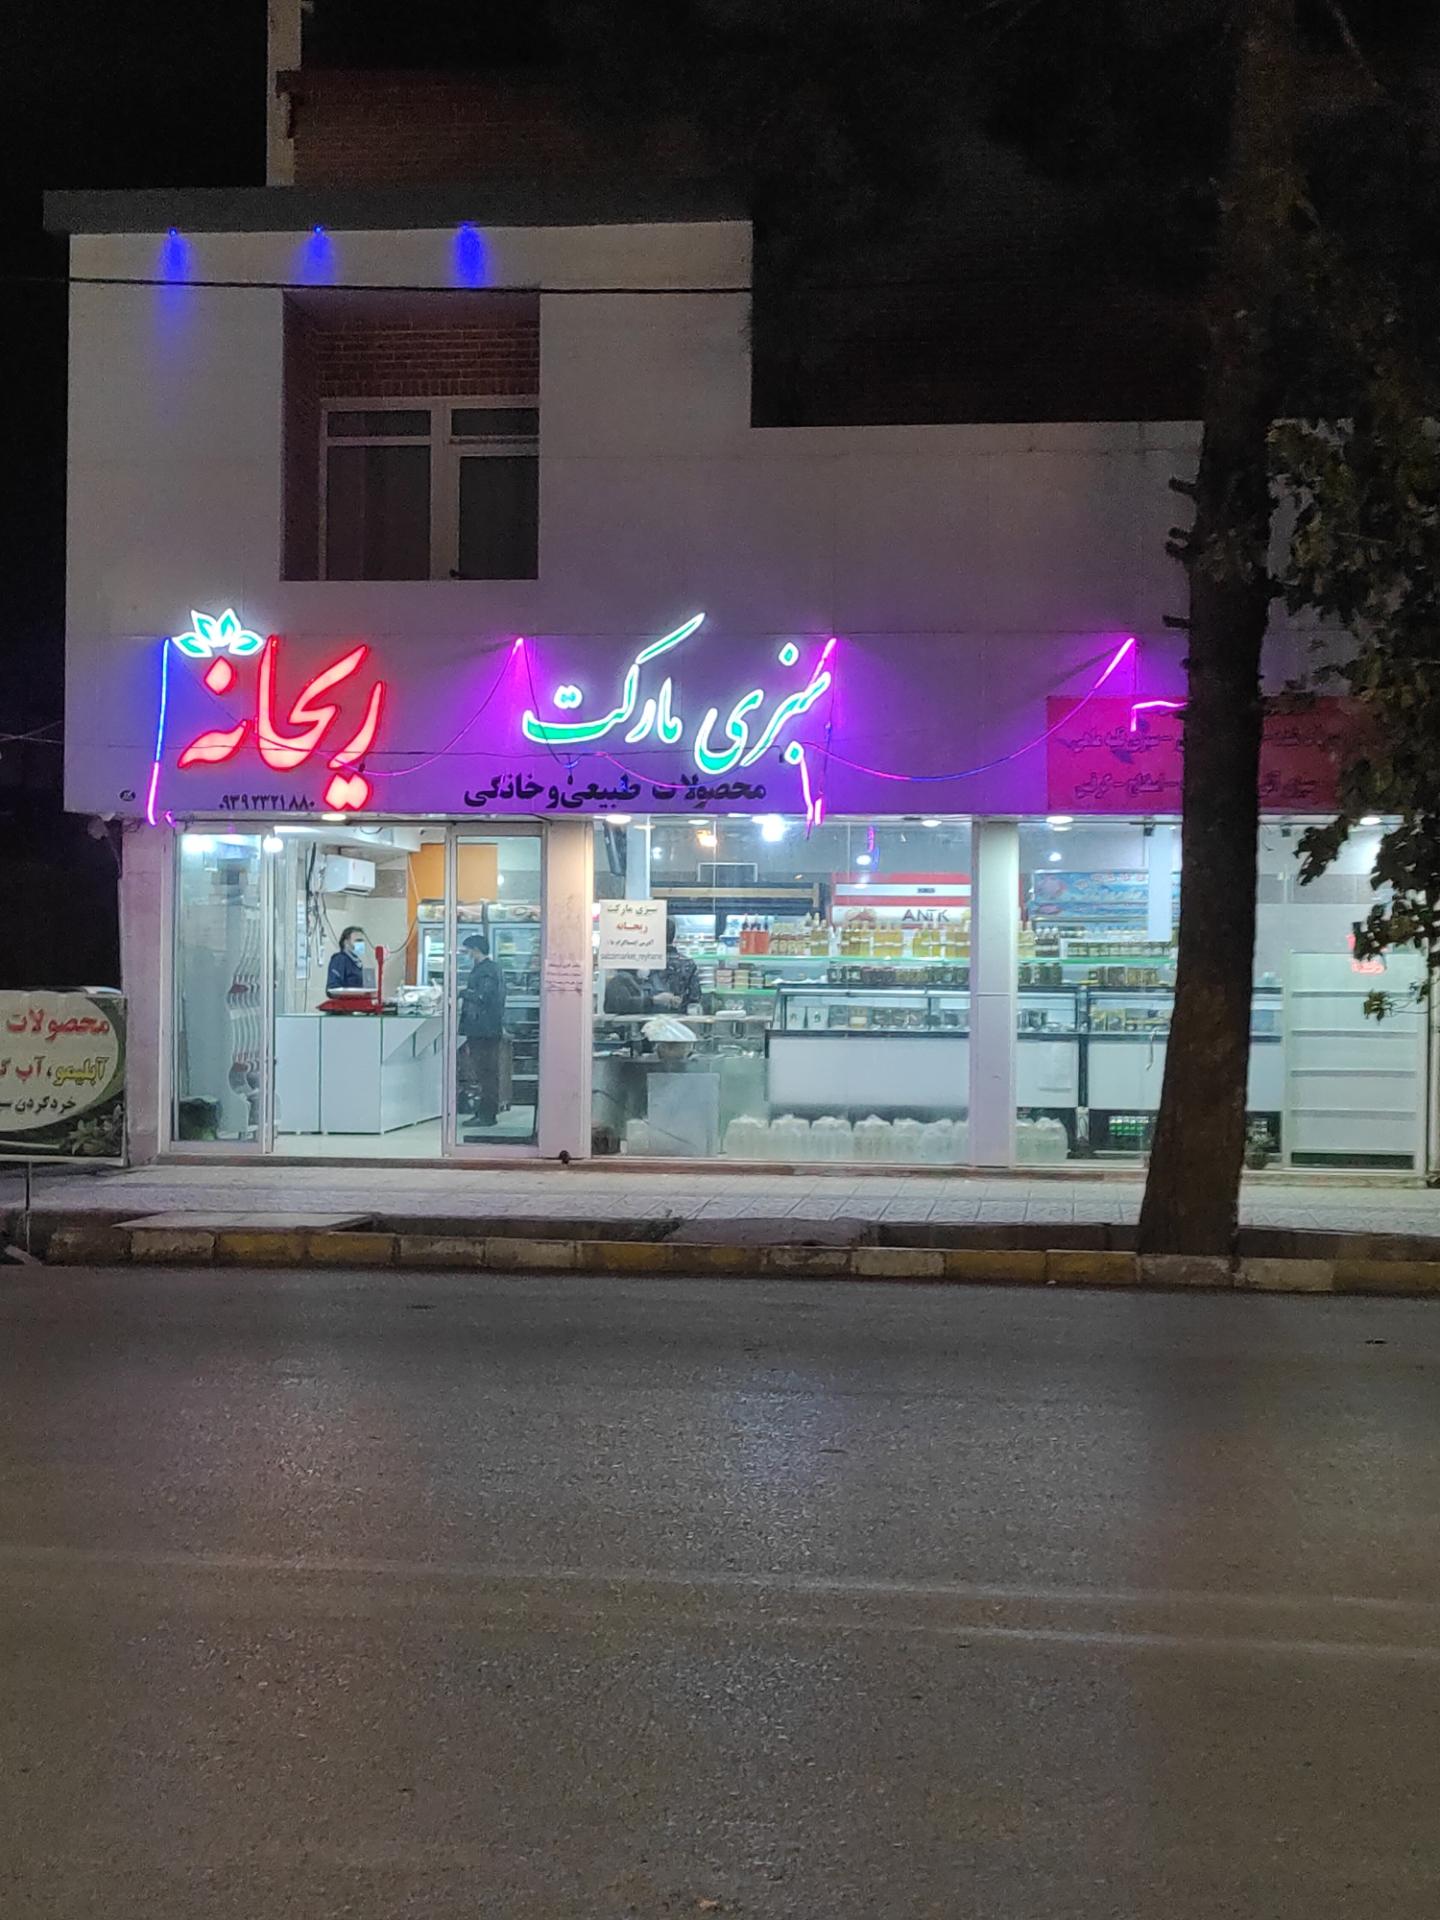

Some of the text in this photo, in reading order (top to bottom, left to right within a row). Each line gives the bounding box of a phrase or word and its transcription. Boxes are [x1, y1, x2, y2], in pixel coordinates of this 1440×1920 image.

[522, 612, 832, 775] سبزی مارکت
[177, 634, 386, 811] ریحانه
[464, 772, 767, 809] محصولات طبیعی و خانگی
[7, 1008, 110, 1041] محصولات
[15, 1055, 47, 1084] آب
